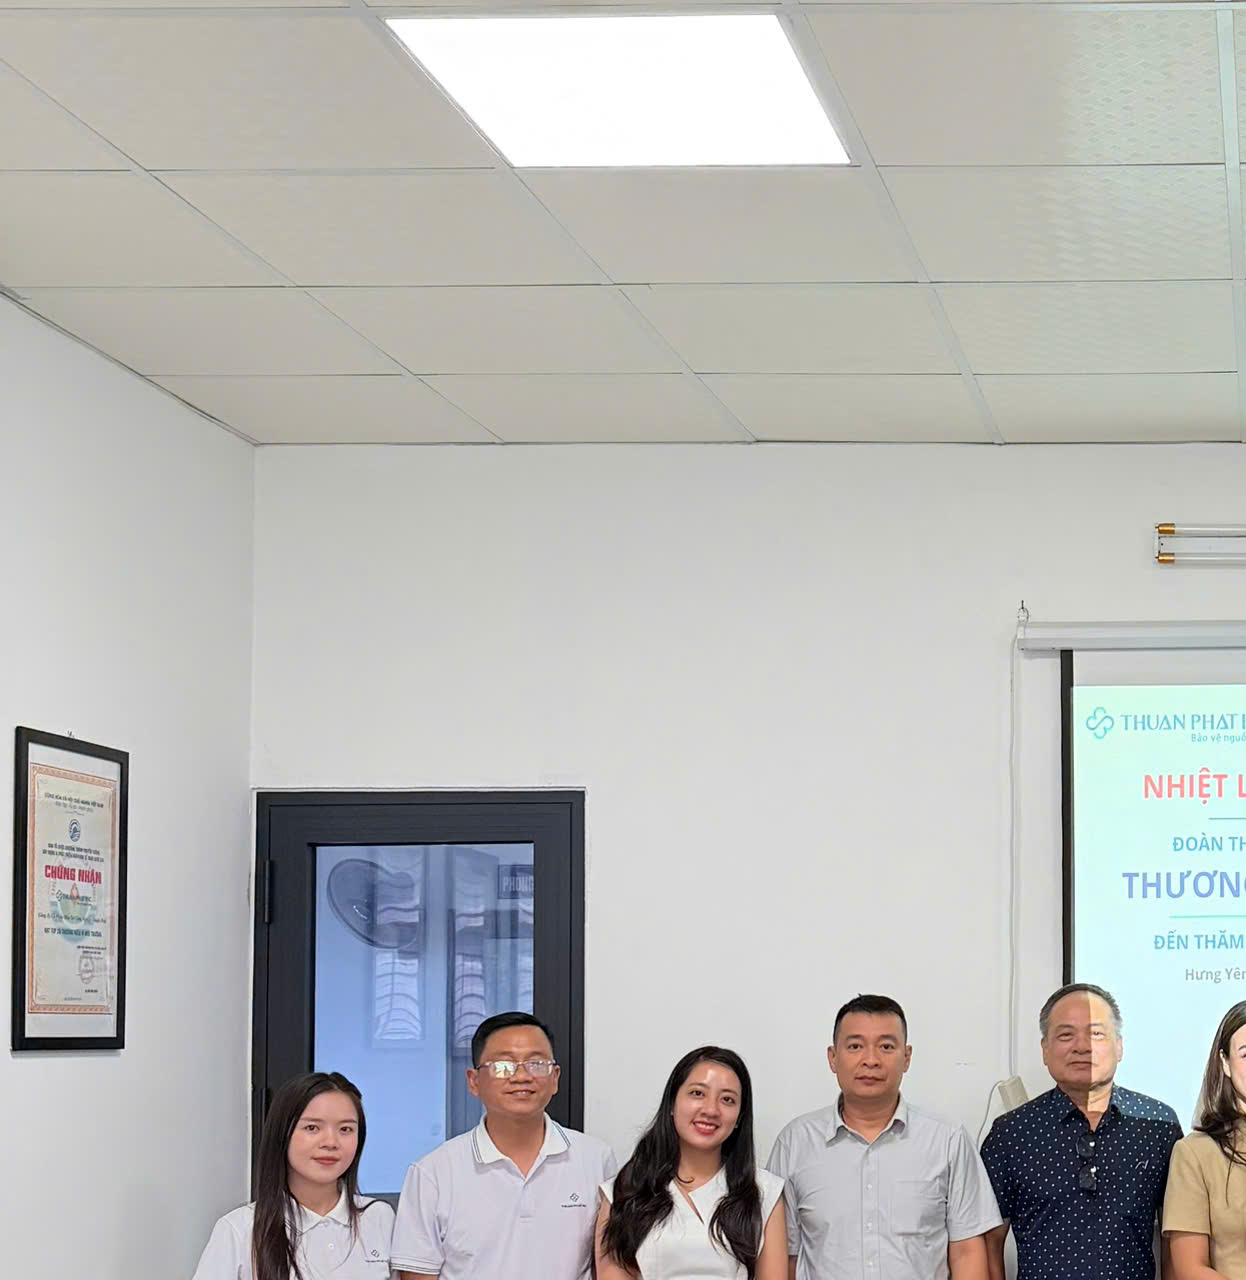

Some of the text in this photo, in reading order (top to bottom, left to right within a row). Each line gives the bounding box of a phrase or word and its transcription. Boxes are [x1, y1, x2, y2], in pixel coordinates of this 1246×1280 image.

[1143, 767, 1228, 804] NHIỆT
[1172, 832, 1223, 851] ĐOÀN
[1153, 929, 1189, 950] ĐẾN
[1194, 930, 1244, 949] THĂM
[1185, 968, 1222, 984] Hưng
